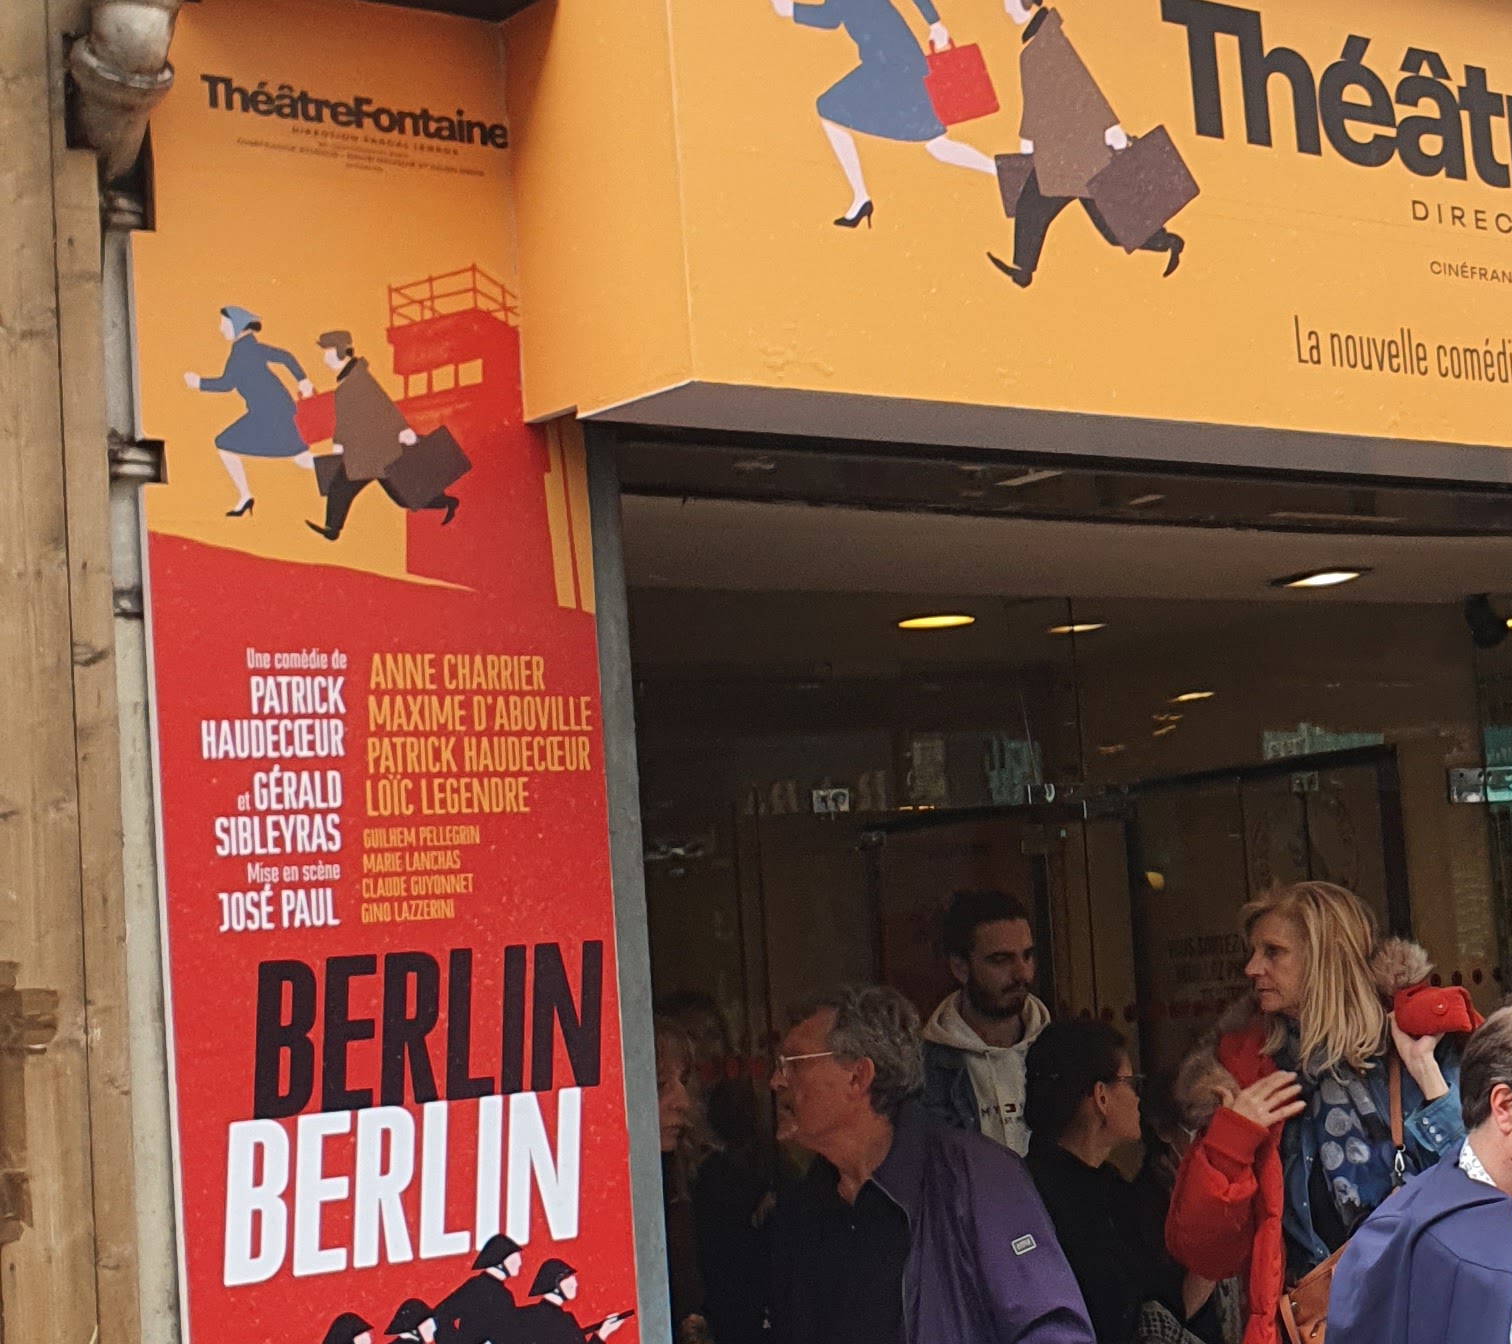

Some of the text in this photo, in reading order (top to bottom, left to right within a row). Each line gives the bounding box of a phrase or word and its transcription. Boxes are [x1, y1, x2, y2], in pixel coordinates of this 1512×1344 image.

[200, 73, 508, 149] ThéâtreFontaine
[1294, 314, 1321, 365] La
[1330, 327, 1428, 376] nouvelle
[246, 647, 347, 669] Une comédie de
[370, 652, 545, 690] ANNE CHARRIER
[250, 675, 346, 715] PATRICK
[368, 695, 592, 731] MAXIME D'ABOVILLE
[201, 718, 345, 760] HAUDECŒUR
[367, 736, 591, 773] PATRICK HAUDECŒUR
[237, 764, 342, 811] et GÉRALD
[366, 774, 530, 817] LOÏC LEGENDRE
[214, 813, 342, 856] SIBLEYRAS
[363, 825, 480, 849] GUILHEM PELLEGRIN
[247, 860, 341, 883] Mise en scène
[363, 851, 402, 873] MARIE
[362, 873, 474, 898] CLAUDE GUYONNET
[218, 883, 341, 932] JOSÉ PAUL
[361, 899, 455, 924] GINO LAZZERINI
[253, 940, 603, 1119] BERLIN
[224, 1087, 581, 1287] BERLIN
